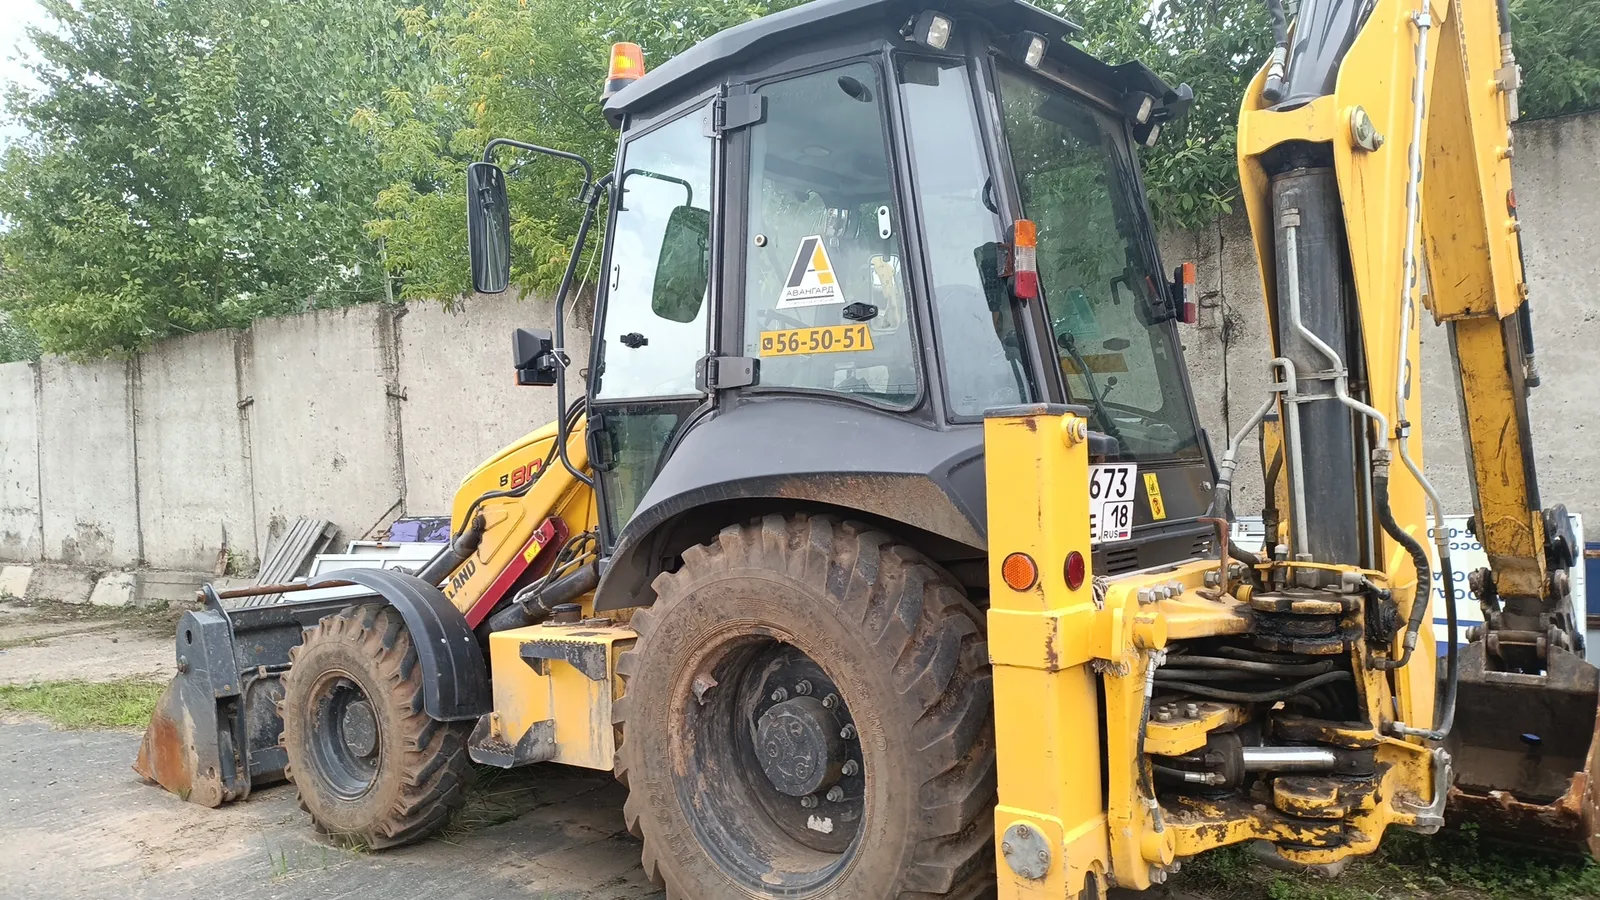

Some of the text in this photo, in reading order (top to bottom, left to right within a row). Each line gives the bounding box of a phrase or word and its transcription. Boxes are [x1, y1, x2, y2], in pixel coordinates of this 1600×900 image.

[786, 286, 835, 297] АВАНГАРД
[776, 326, 866, 353] 56-50-51
[1089, 467, 1129, 500] 673
[1110, 504, 1129, 529] 18
[1103, 530, 1119, 539] RUS
